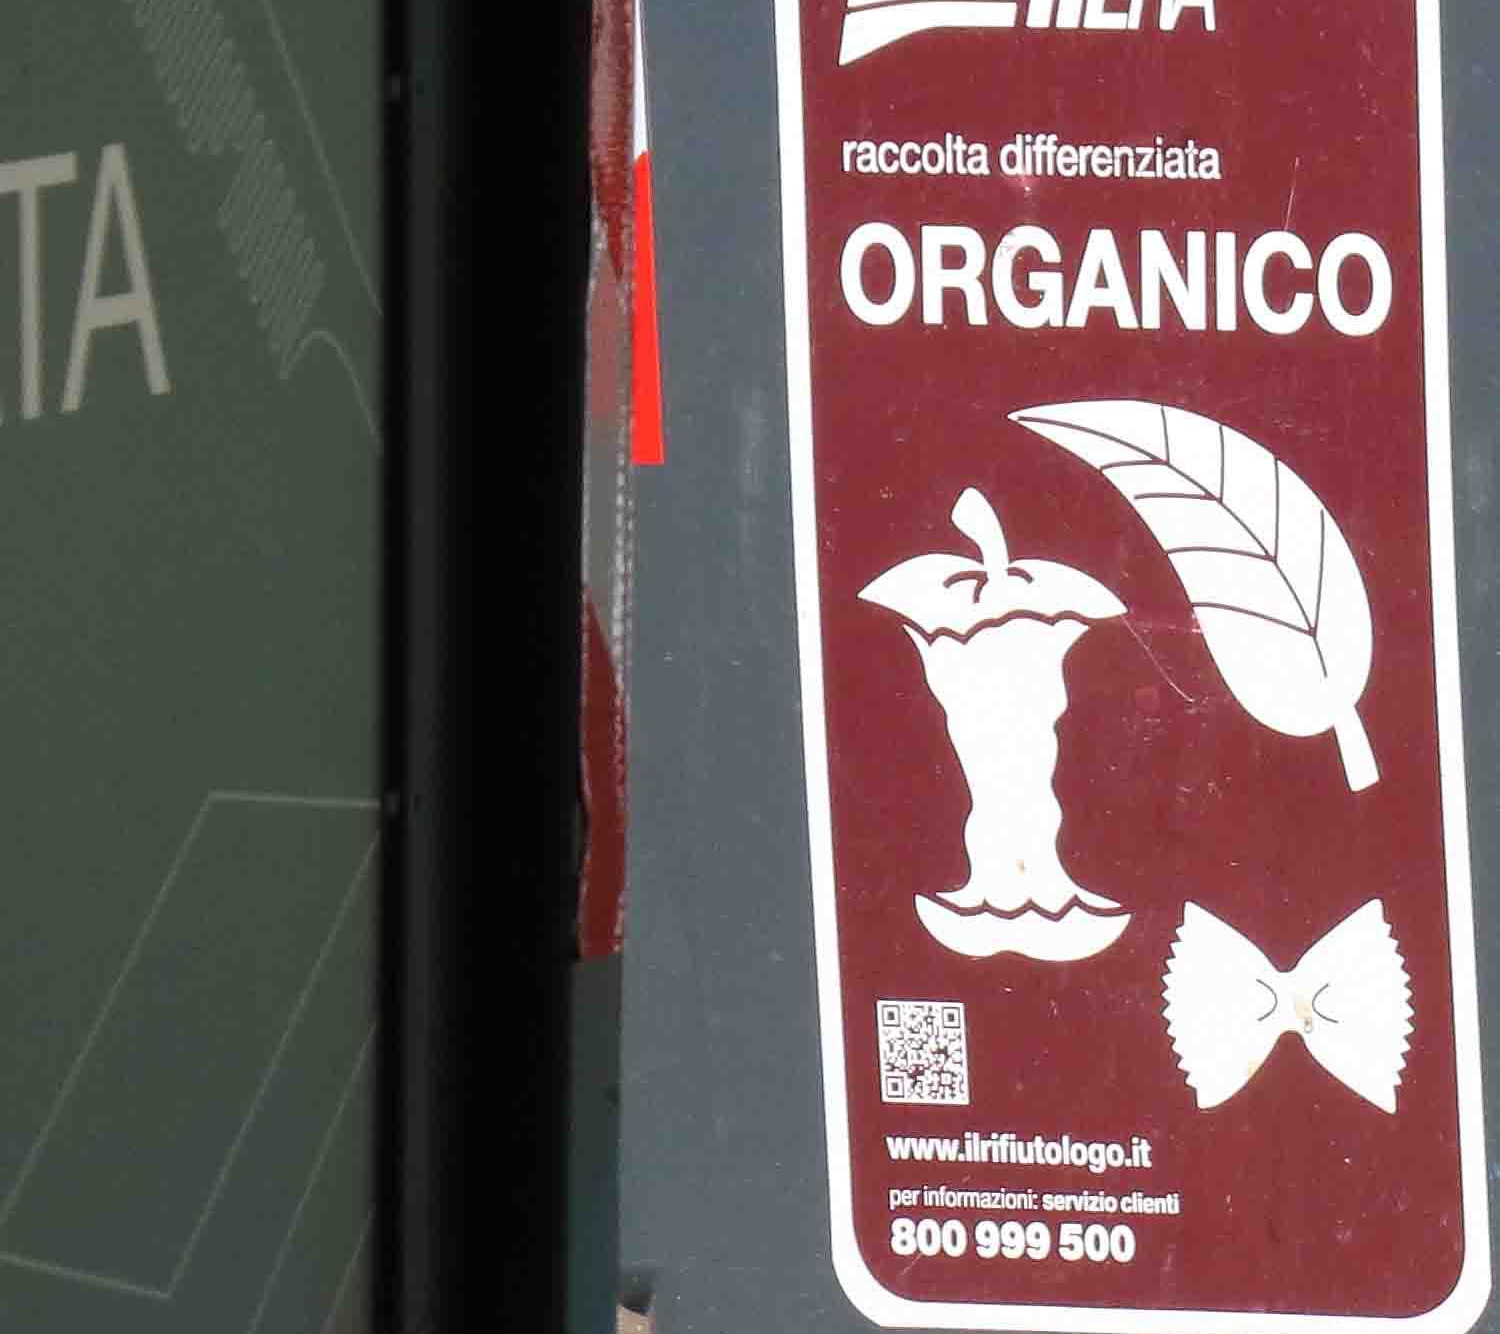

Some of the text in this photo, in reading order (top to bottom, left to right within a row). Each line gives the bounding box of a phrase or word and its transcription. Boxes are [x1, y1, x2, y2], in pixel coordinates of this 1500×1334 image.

[841, 134, 1221, 179] raccolta differenziata
[840, 223, 1393, 336] ORGANICO
[887, 1133, 1151, 1173] www.ilrifiutologo.it
[889, 1186, 1179, 1214] per informazioni: servizio clienti
[890, 1218, 1135, 1261] 800 999 500
